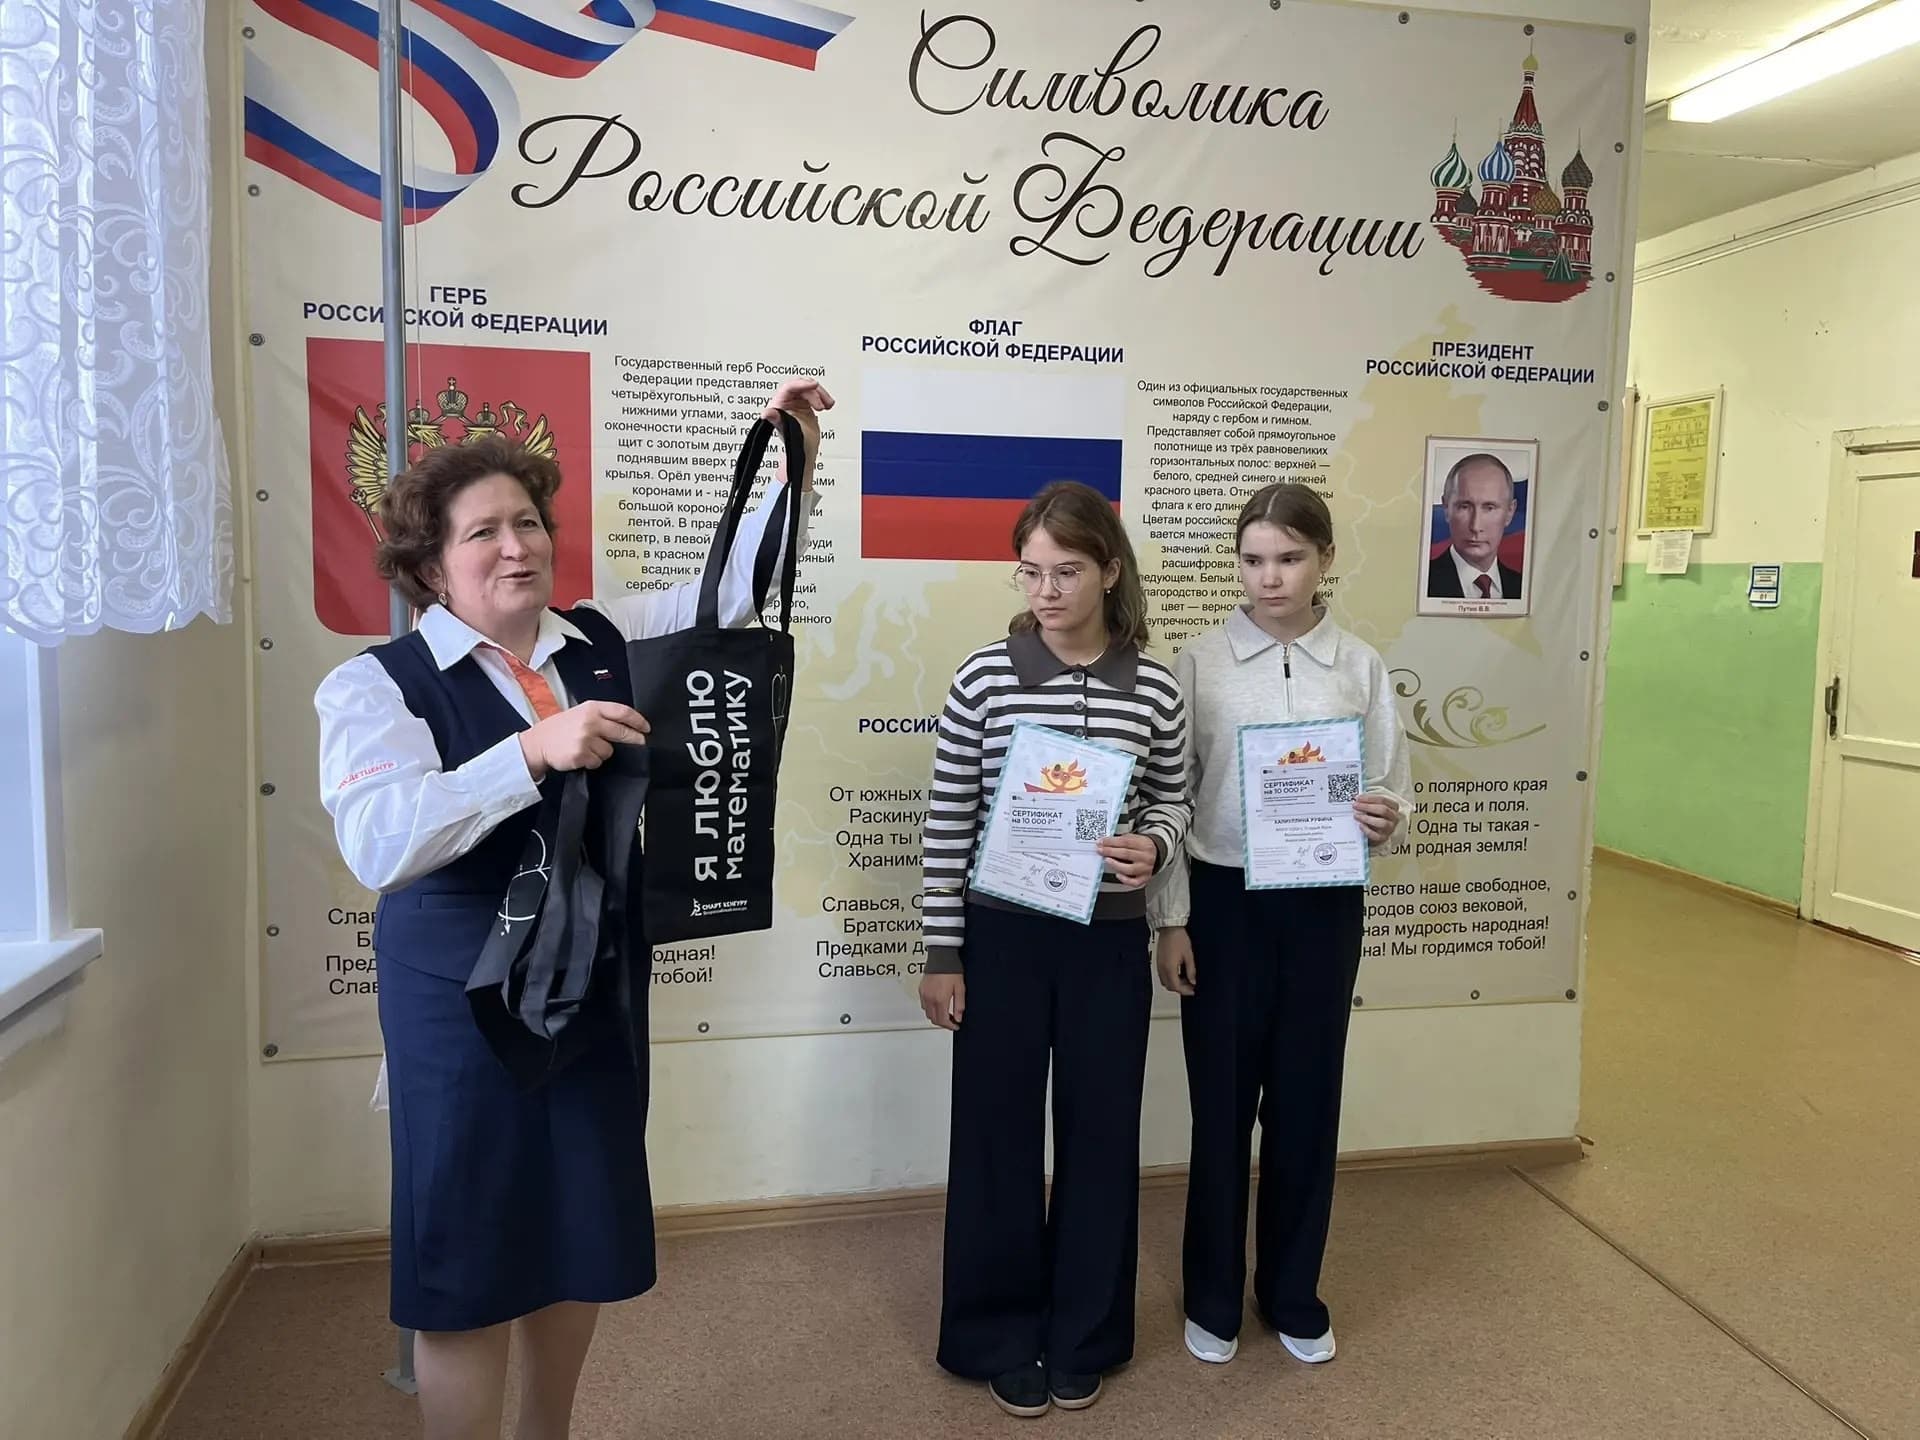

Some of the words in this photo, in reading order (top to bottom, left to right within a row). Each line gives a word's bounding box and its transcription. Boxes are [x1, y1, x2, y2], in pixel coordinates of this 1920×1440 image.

[908, 9, 1330, 130] Символика
[510, 113, 990, 233] Российской
[1009, 131, 1425, 279] Федерации
[430, 285, 487, 306] ГЕРБ
[303, 302, 464, 329] РОССИСКОЙ
[471, 313, 608, 337] ФЕДЕРАЦИИ
[968, 319, 1023, 336] ФЛАГ
[862, 335, 999, 358] РОССИЙСКОЙ
[1005, 343, 1124, 365] ФЕДЕРАЦИИ
[1432, 341, 1535, 361] ПРЕЗИДЕНТ
[614, 355, 723, 372] Государственный
[726, 361, 753, 374] герб
[756, 362, 826, 377] Российской
[1366, 358, 1486, 379] РОССИЙСКОЙ
[1490, 365, 1594, 385] ФЕДЕРАЦИИ
[622, 371, 693, 387] Федерации
[696, 376, 780, 391] представляет
[611, 388, 724, 405] четырёхугольный,
[727, 395, 735, 404] с
[1137, 380, 1166, 393] Один
[1168, 384, 1181, 392] из
[1183, 382, 1258, 396] официальных
[1260, 386, 1348, 399] государственных
[1153, 398, 1204, 408] символов
[1207, 397, 1268, 410] Российской
[1271, 399, 1332, 413] Федерации,
[621, 406, 678, 418] нижними
[680, 409, 728, 421] углами,
[1172, 413, 1210, 424] наряду
[1213, 415, 1220, 423] с
[1222, 414, 1259, 427] гербом
[1262, 417, 1269, 425] и
[1271, 417, 1312, 426] гимном.
[604, 421, 683, 434] оконечности
[685, 424, 738, 438] красный
[1147, 426, 1222, 440] Представляет
[1224, 428, 1255, 439] собой
[1258, 431, 1337, 443] прямоугольное
[618, 437, 643, 449] щит
[646, 440, 654, 448] с
[656, 440, 710, 450] золотым
[1153, 442, 1213, 454] полотнище
[1216, 445, 1227, 453] из
[1230, 444, 1254, 455] трёх
[1256, 446, 1329, 457] равновеликих
[617, 453, 689, 466] поднявшим
[691, 457, 727, 469] вверх
[1150, 457, 1235, 469] горизонтальных
[1237, 459, 1272, 469] полос:
[1274, 459, 1317, 471] верхней
[605, 469, 655, 480] крылья.
[657, 469, 692, 482] Орёл
[1153, 470, 1192, 483] белого,
[1195, 473, 1239, 486] средней
[1241, 475, 1277, 484] синего
[1279, 476, 1286, 484] и
[1288, 475, 1327, 485] нижней
[632, 485, 692, 497] коронами
[694, 488, 703, 496] и
[1144, 486, 1191, 498] красного
[1193, 488, 1226, 498] цвета.
[618, 500, 674, 512] большой
[1151, 500, 1185, 512] флага
[1187, 502, 1193, 510] к
[1195, 502, 1212, 512] его
[628, 517, 675, 528] лентой.
[678, 518, 687, 527] В
[1142, 515, 1183, 527] Цветам
[608, 532, 663, 545] скипетр,
[663, 535, 671, 543] в
[674, 534, 711, 545] левой
[1150, 530, 1186, 539] вается
[606, 550, 640, 562] орла,
[643, 550, 651, 559] в
[654, 550, 705, 561] красном
[1161, 544, 1212, 555] значений.
[641, 564, 691, 576] всадник
[694, 567, 701, 575] в
[1162, 559, 1235, 571] расшифровка
[1200, 572, 1236, 584] Белый
[1211, 589, 1218, 598] и
[1161, 602, 1185, 614] цвет
[1213, 618, 1220, 626] и
[1164, 631, 1188, 642] цвет
[686, 670, 724, 840] люблю
[723, 669, 752, 880] математику
[1264, 779, 1314, 789] СЕРТИФИКАТ
[1283, 786, 1299, 794] 000
[1428, 779, 1509, 796] полярного
[1513, 779, 1548, 796] края
[829, 786, 854, 802] От
[860, 789, 923, 802] южных
[1012, 809, 1063, 819] СЕРТИФИКАТ
[1432, 801, 1470, 814] леса
[1474, 801, 1484, 813] и
[1489, 800, 1529, 813] поля.
[1416, 819, 1458, 836] Одна
[1463, 821, 1482, 833] ты
[1488, 819, 1530, 833] такая
[836, 830, 884, 848] Одна
[890, 832, 912, 846] ты
[1416, 841, 1472, 858] родная
[1476, 837, 1528, 853] земля!
[694, 855, 718, 881] Я
[1419, 882, 1461, 896] наше
[1465, 877, 1551, 893] свободное,
[822, 896, 905, 913] Славься,
[1419, 902, 1458, 916] союз
[1462, 897, 1528, 914] вековой,
[843, 918, 924, 937] Братских
[1394, 921, 1468, 939] мудрость
[1472, 915, 1550, 934] народная!
[816, 940, 907, 960] Предками
[1391, 941, 1417, 957] Мы
[1422, 939, 1493, 957] гордимся
[1497, 936, 1546, 952] тобой!
[652, 967, 713, 984] тобой!
[818, 962, 901, 978] Славься,
